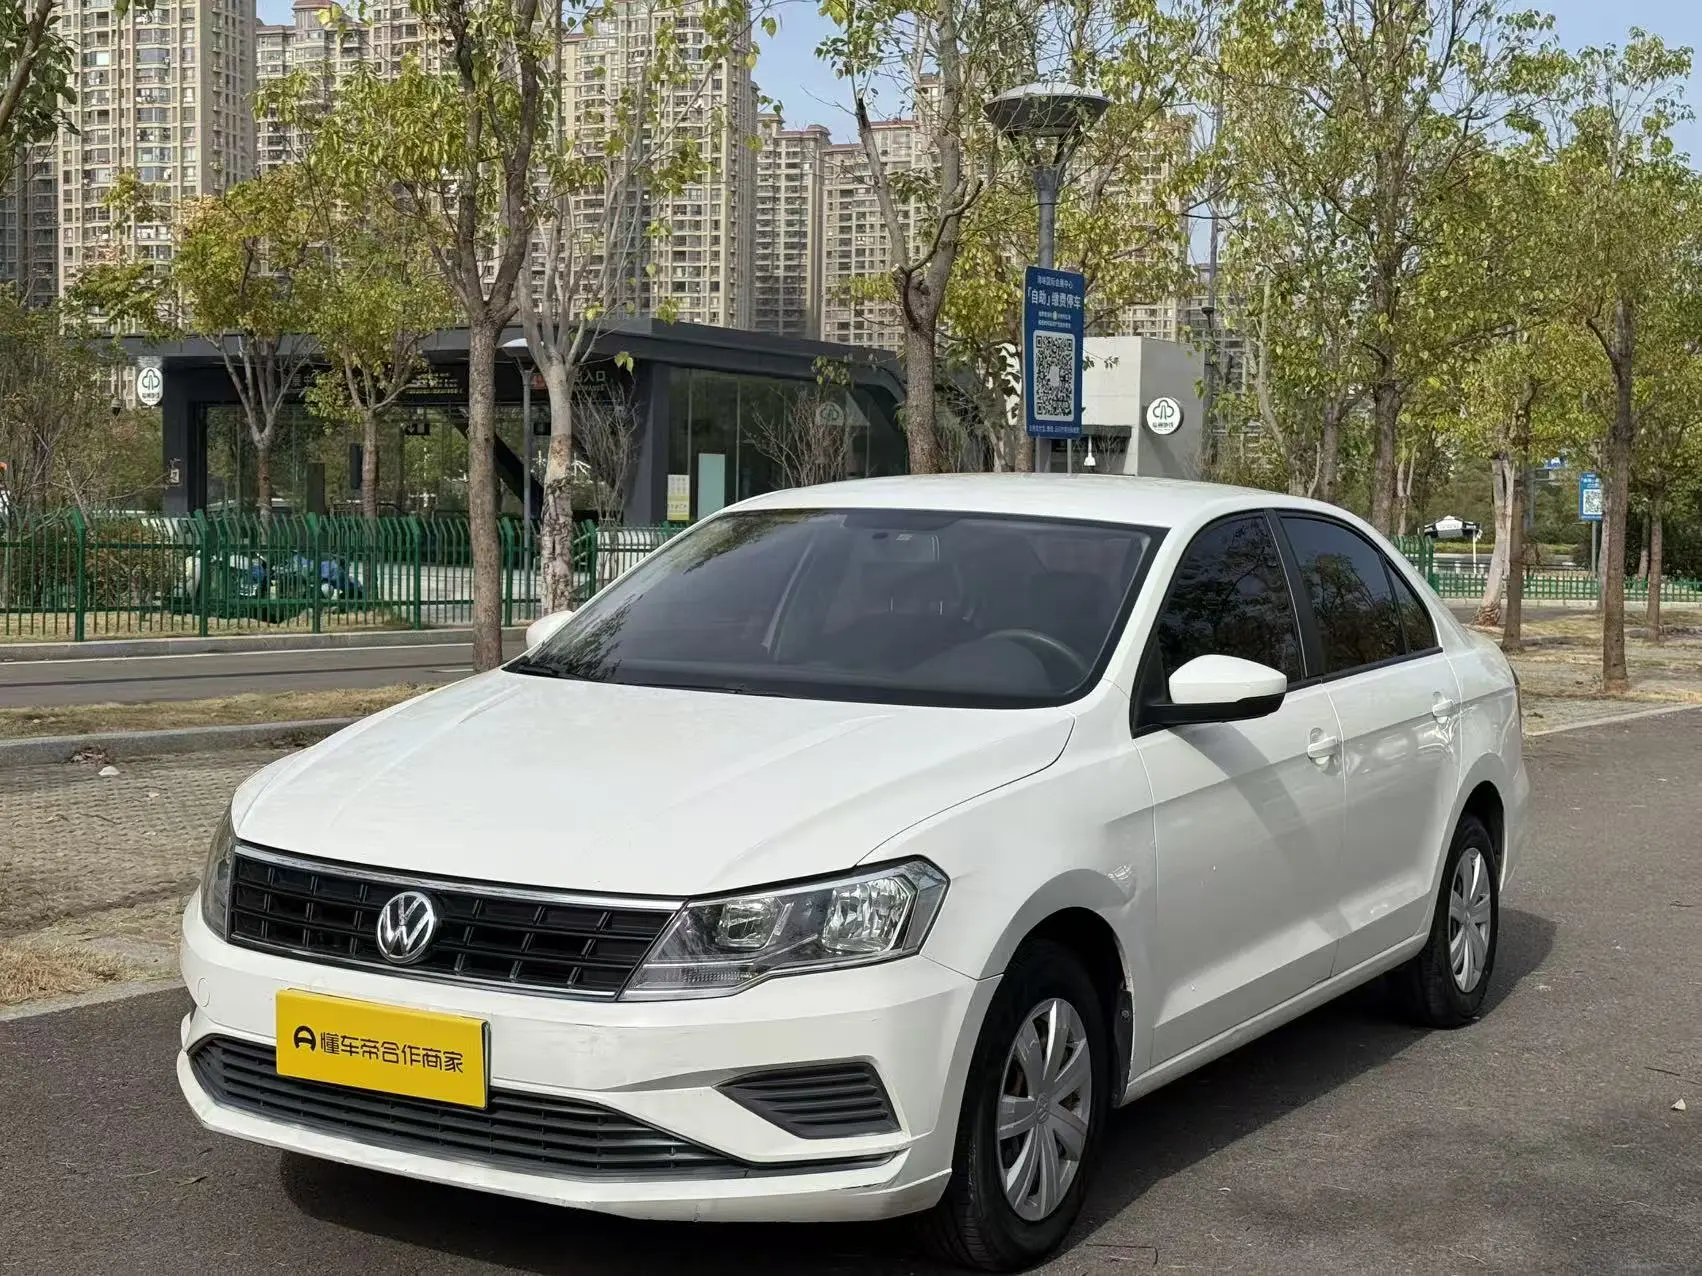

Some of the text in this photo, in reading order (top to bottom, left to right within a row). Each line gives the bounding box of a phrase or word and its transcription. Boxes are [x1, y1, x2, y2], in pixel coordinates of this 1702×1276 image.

[320, 1031, 464, 1074] 懂车帝合作商家
